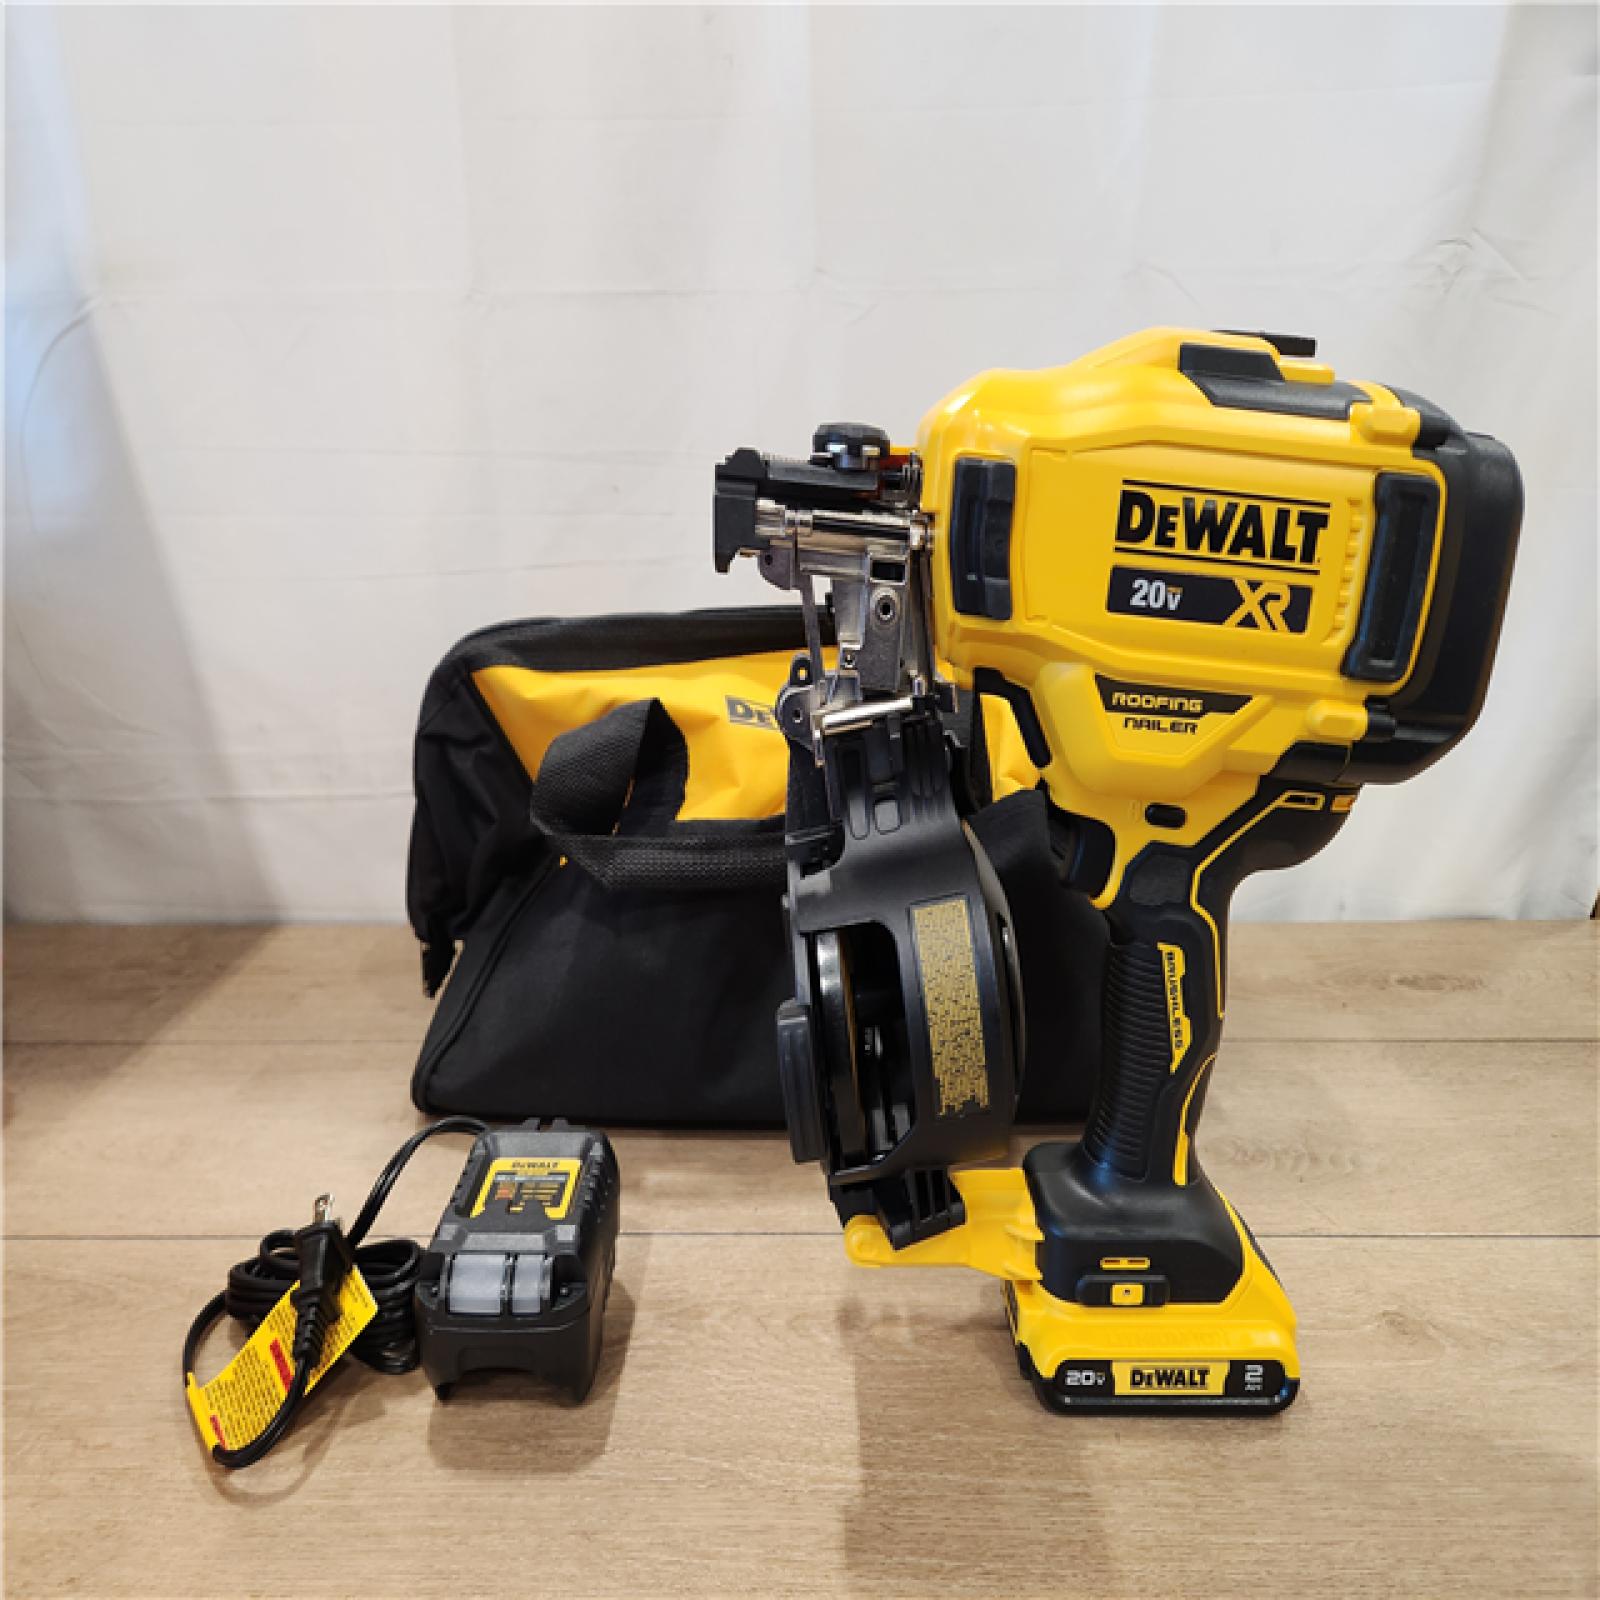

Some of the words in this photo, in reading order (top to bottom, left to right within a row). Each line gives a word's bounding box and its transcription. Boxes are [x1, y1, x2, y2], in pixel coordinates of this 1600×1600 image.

[1221, 578, 1292, 634] XR
[1111, 691, 1204, 713] ROOFING
[1123, 716, 1199, 735] NAILER
[1129, 1367, 1210, 1389] DEWALT
[1244, 1364, 1264, 1382] 2
